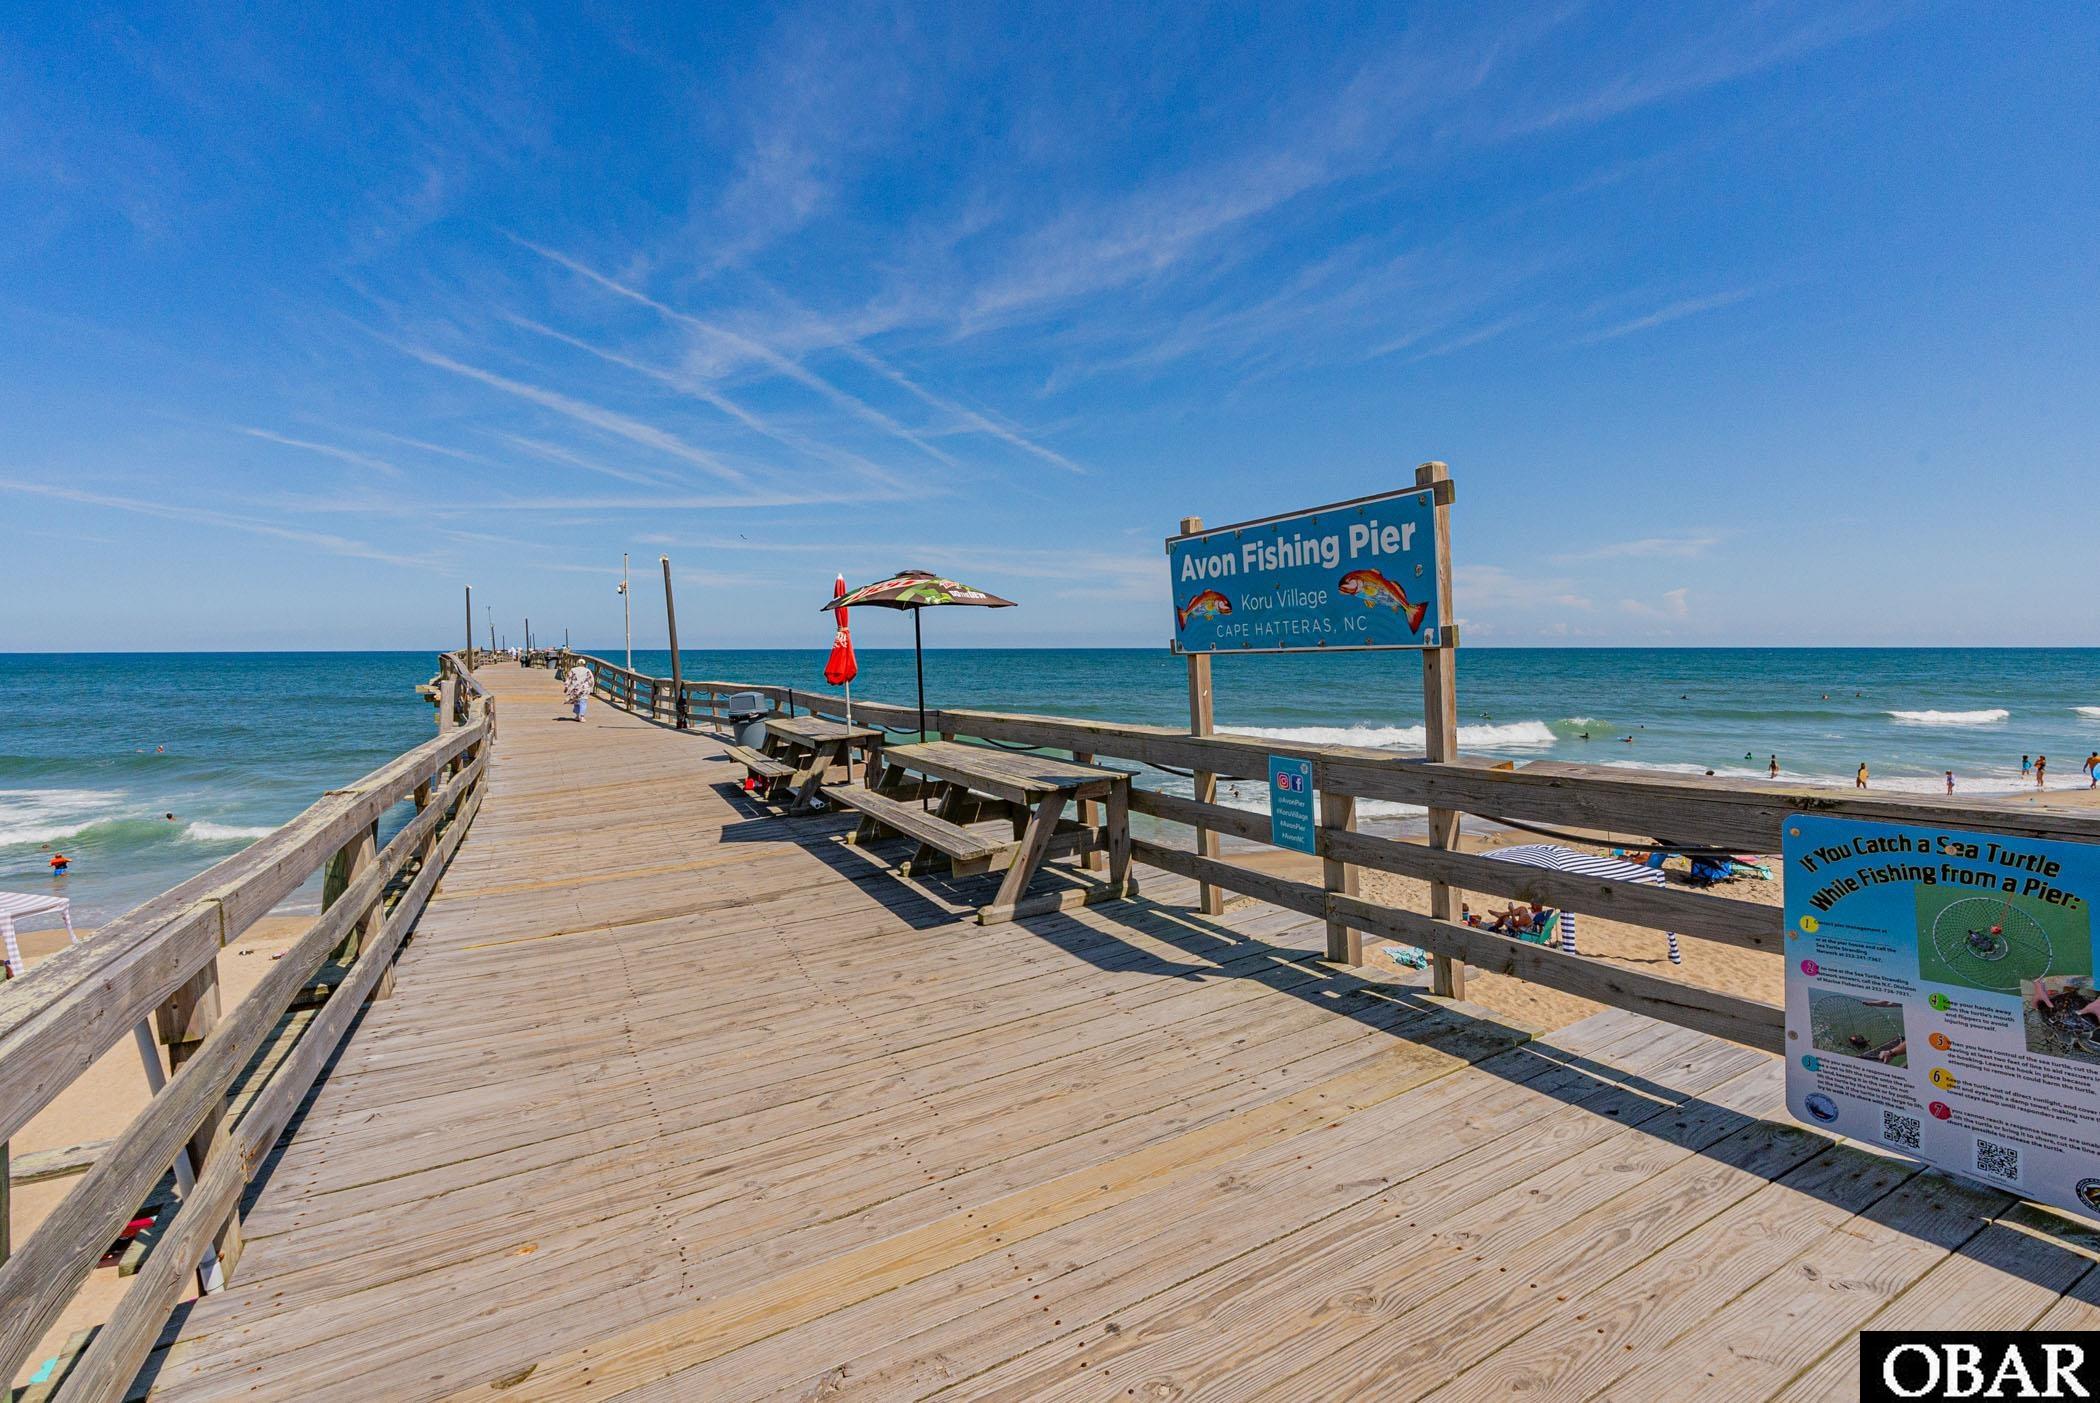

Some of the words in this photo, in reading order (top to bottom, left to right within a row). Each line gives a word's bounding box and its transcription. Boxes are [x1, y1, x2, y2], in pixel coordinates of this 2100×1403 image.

[1180, 553, 1236, 583] Avon
[1242, 532, 1340, 574] Fishing
[1349, 519, 1416, 559] Pier
[1241, 593, 1273, 611] Koru
[1276, 587, 1328, 610] Village
[1216, 620, 1250, 639] CAPE
[1255, 617, 1338, 636] HATTERAS,
[1344, 615, 1369, 632] NC
[1813, 844, 1852, 865] You
[1852, 833, 1912, 856] Catch
[1918, 838, 1930, 853] a
[1936, 836, 1979, 859] Sea
[1986, 842, 2061, 878] Turtle
[1809, 878, 1860, 912] While
[1856, 863, 1937, 885] Fishing
[1940, 863, 1997, 889] from
[2002, 876, 2018, 893] a
[2022, 878, 2082, 911] Pier:
[1930, 994, 1938, 1006] 4
[1936, 1035, 1944, 1047] 5
[1932, 1070, 1941, 1083] 6
[1934, 1103, 1942, 1117] 7
